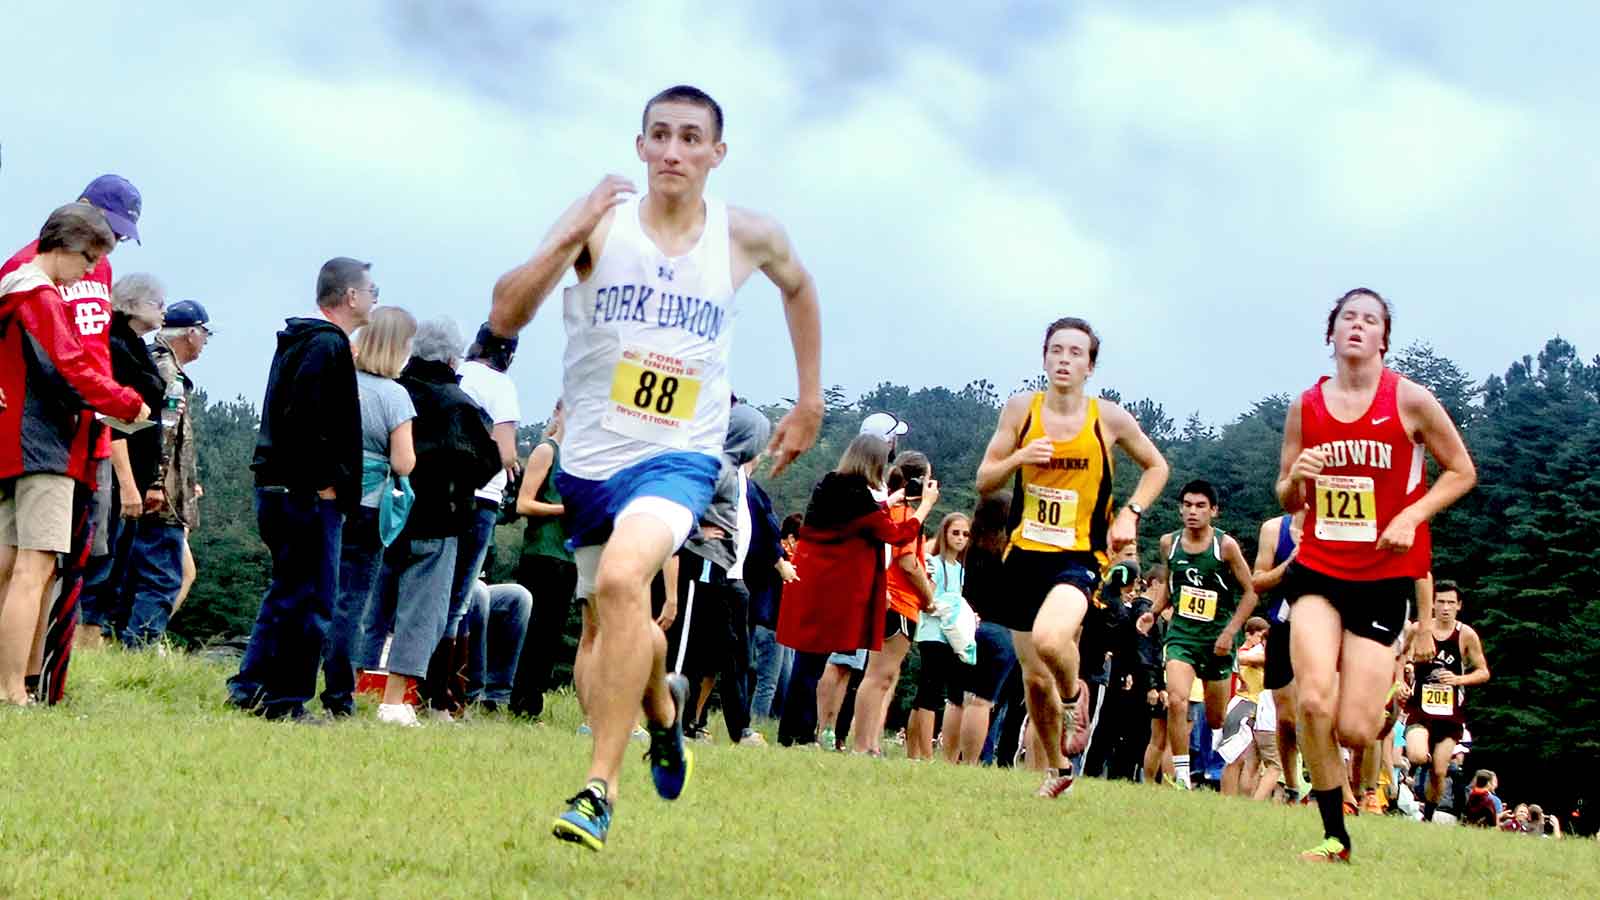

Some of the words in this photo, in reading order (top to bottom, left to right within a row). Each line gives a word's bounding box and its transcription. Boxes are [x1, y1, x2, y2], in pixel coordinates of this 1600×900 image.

[592, 284, 654, 327] FORK
[657, 292, 725, 342] UNION
[643, 359, 684, 376] UNION
[648, 351, 684, 366] FORK
[633, 370, 679, 415] 88
[1313, 439, 1393, 470] ODWIN
[1037, 498, 1061, 526] 80
[1325, 490, 1366, 519] 121
[1188, 596, 1206, 615] 49
[1426, 690, 1449, 705] 204
